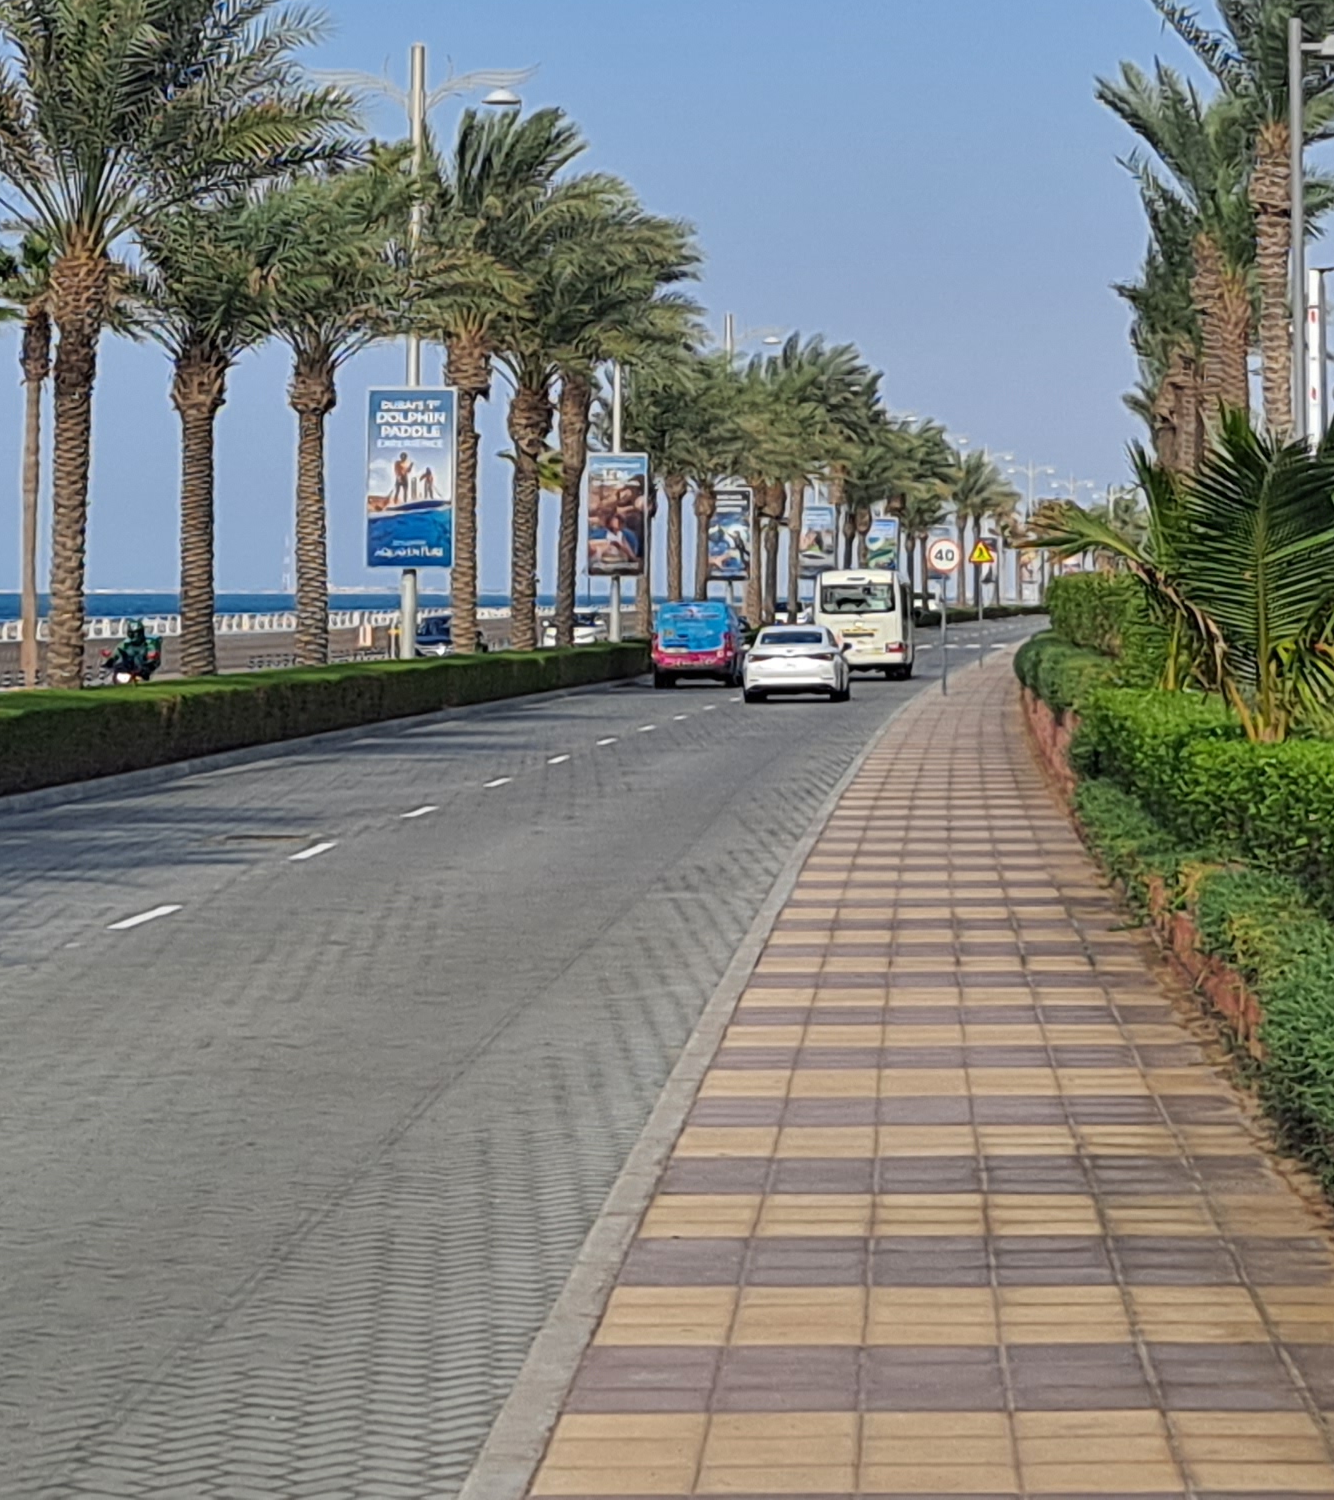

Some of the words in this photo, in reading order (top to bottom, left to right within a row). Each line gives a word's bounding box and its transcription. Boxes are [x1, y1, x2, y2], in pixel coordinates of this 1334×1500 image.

[376, 411, 445, 424] DOLPHIN
[380, 425, 442, 438] PADDLE
[934, 548, 955, 561] 40
